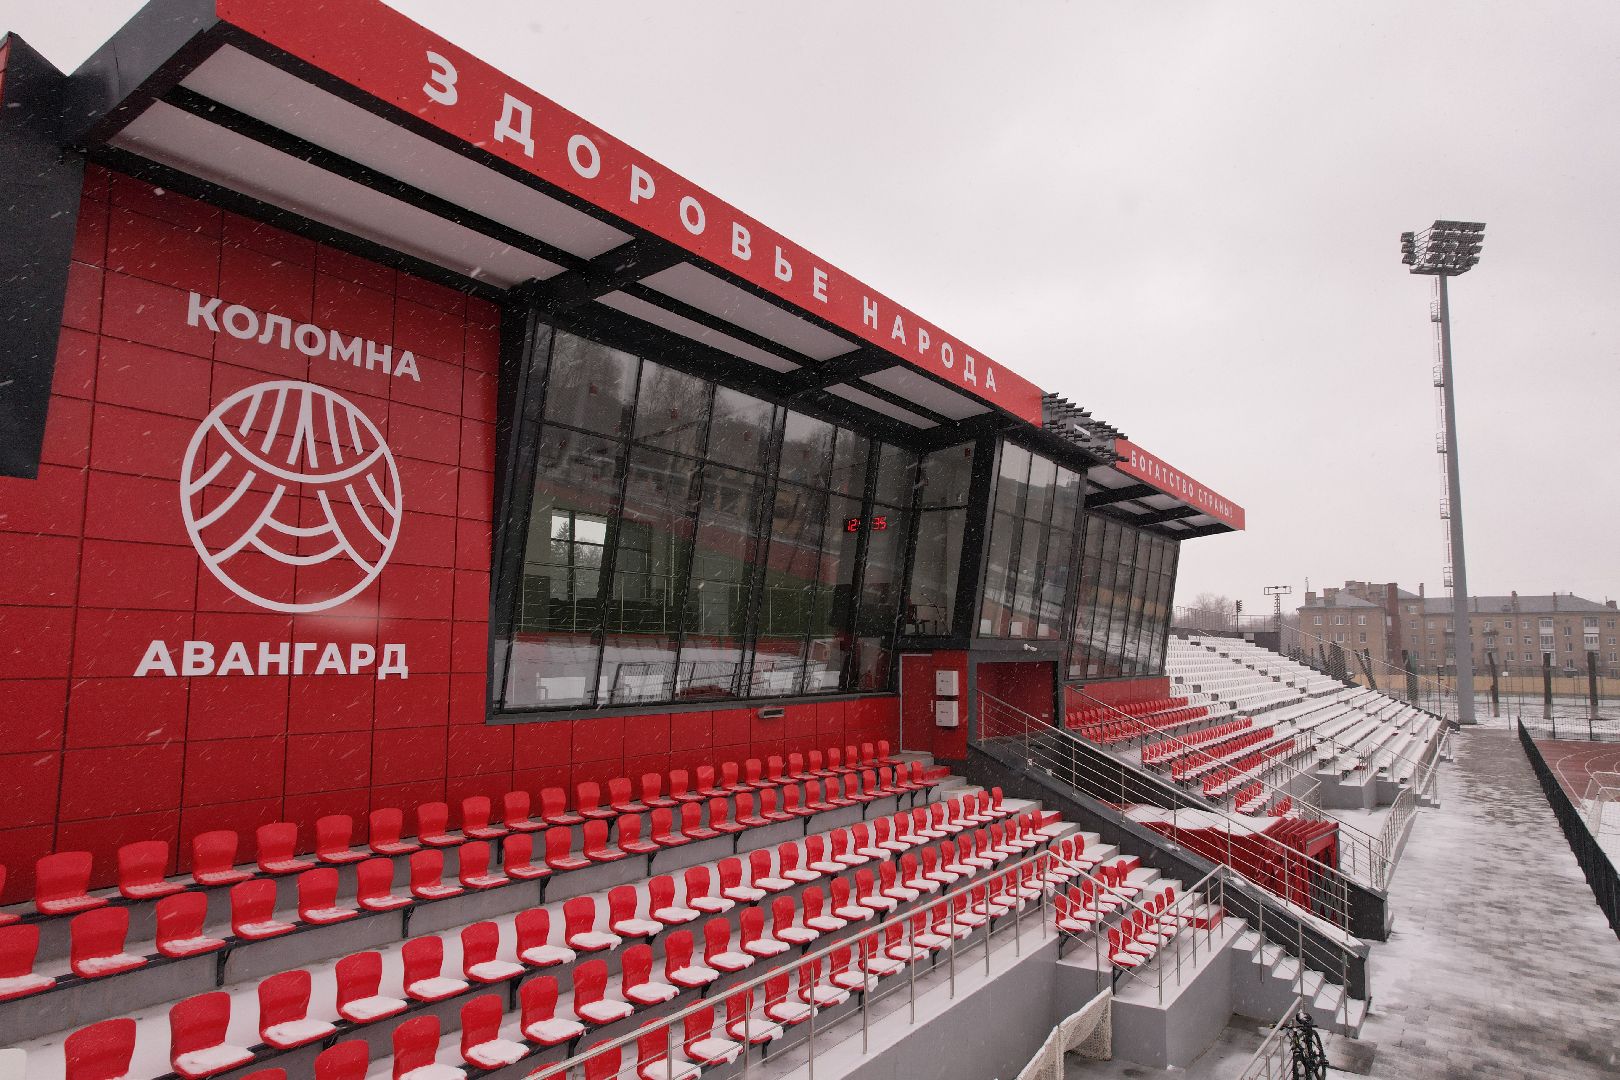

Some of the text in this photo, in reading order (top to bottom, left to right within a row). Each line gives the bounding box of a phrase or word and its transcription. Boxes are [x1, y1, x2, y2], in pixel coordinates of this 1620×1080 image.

[422, 50, 998, 393] ЗДОРОВЬЕ НАРОДА
[186, 291, 422, 383] КОЛОМНА
[1131, 449, 1194, 498] БОГАТСТВО
[133, 640, 410, 680] АВАНГАРД
